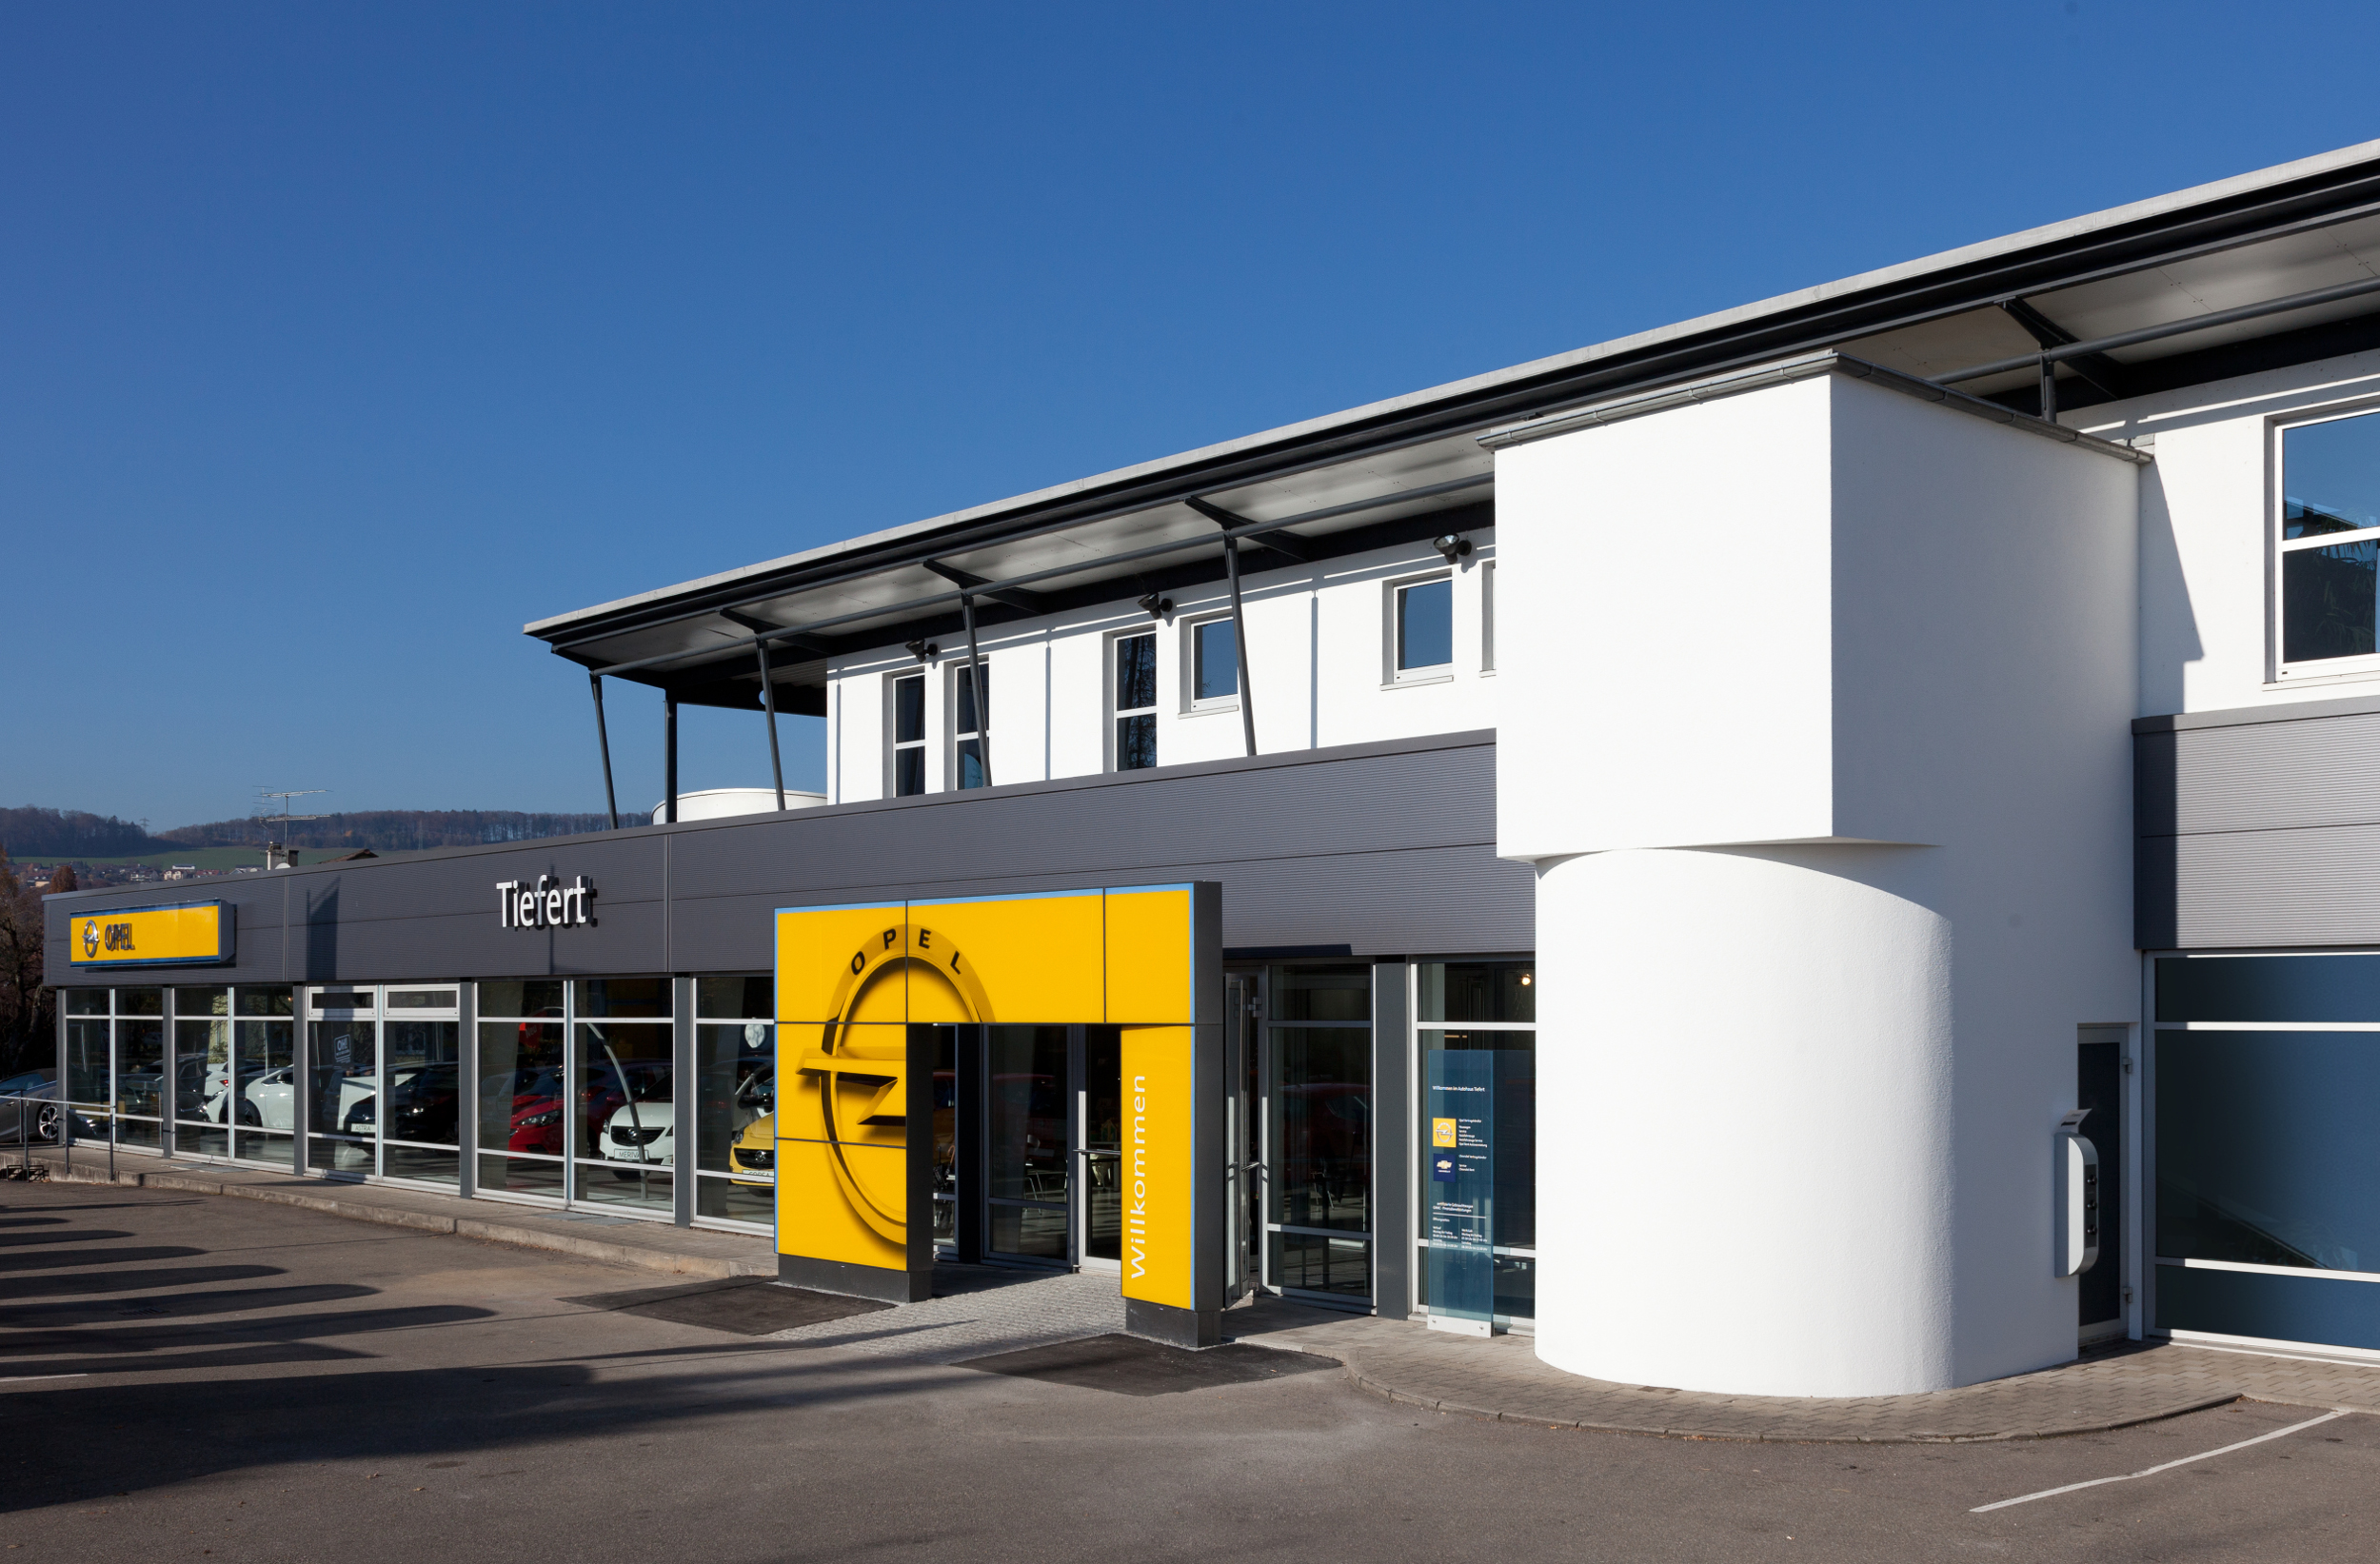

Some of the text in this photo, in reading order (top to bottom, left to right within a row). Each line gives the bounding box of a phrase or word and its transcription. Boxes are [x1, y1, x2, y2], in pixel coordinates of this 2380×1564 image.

[496, 874, 586, 927] Tiefert
[105, 923, 135, 952] OPEL
[850, 928, 962, 976] OPEL
[1130, 1076, 1145, 1279] Willkommen
